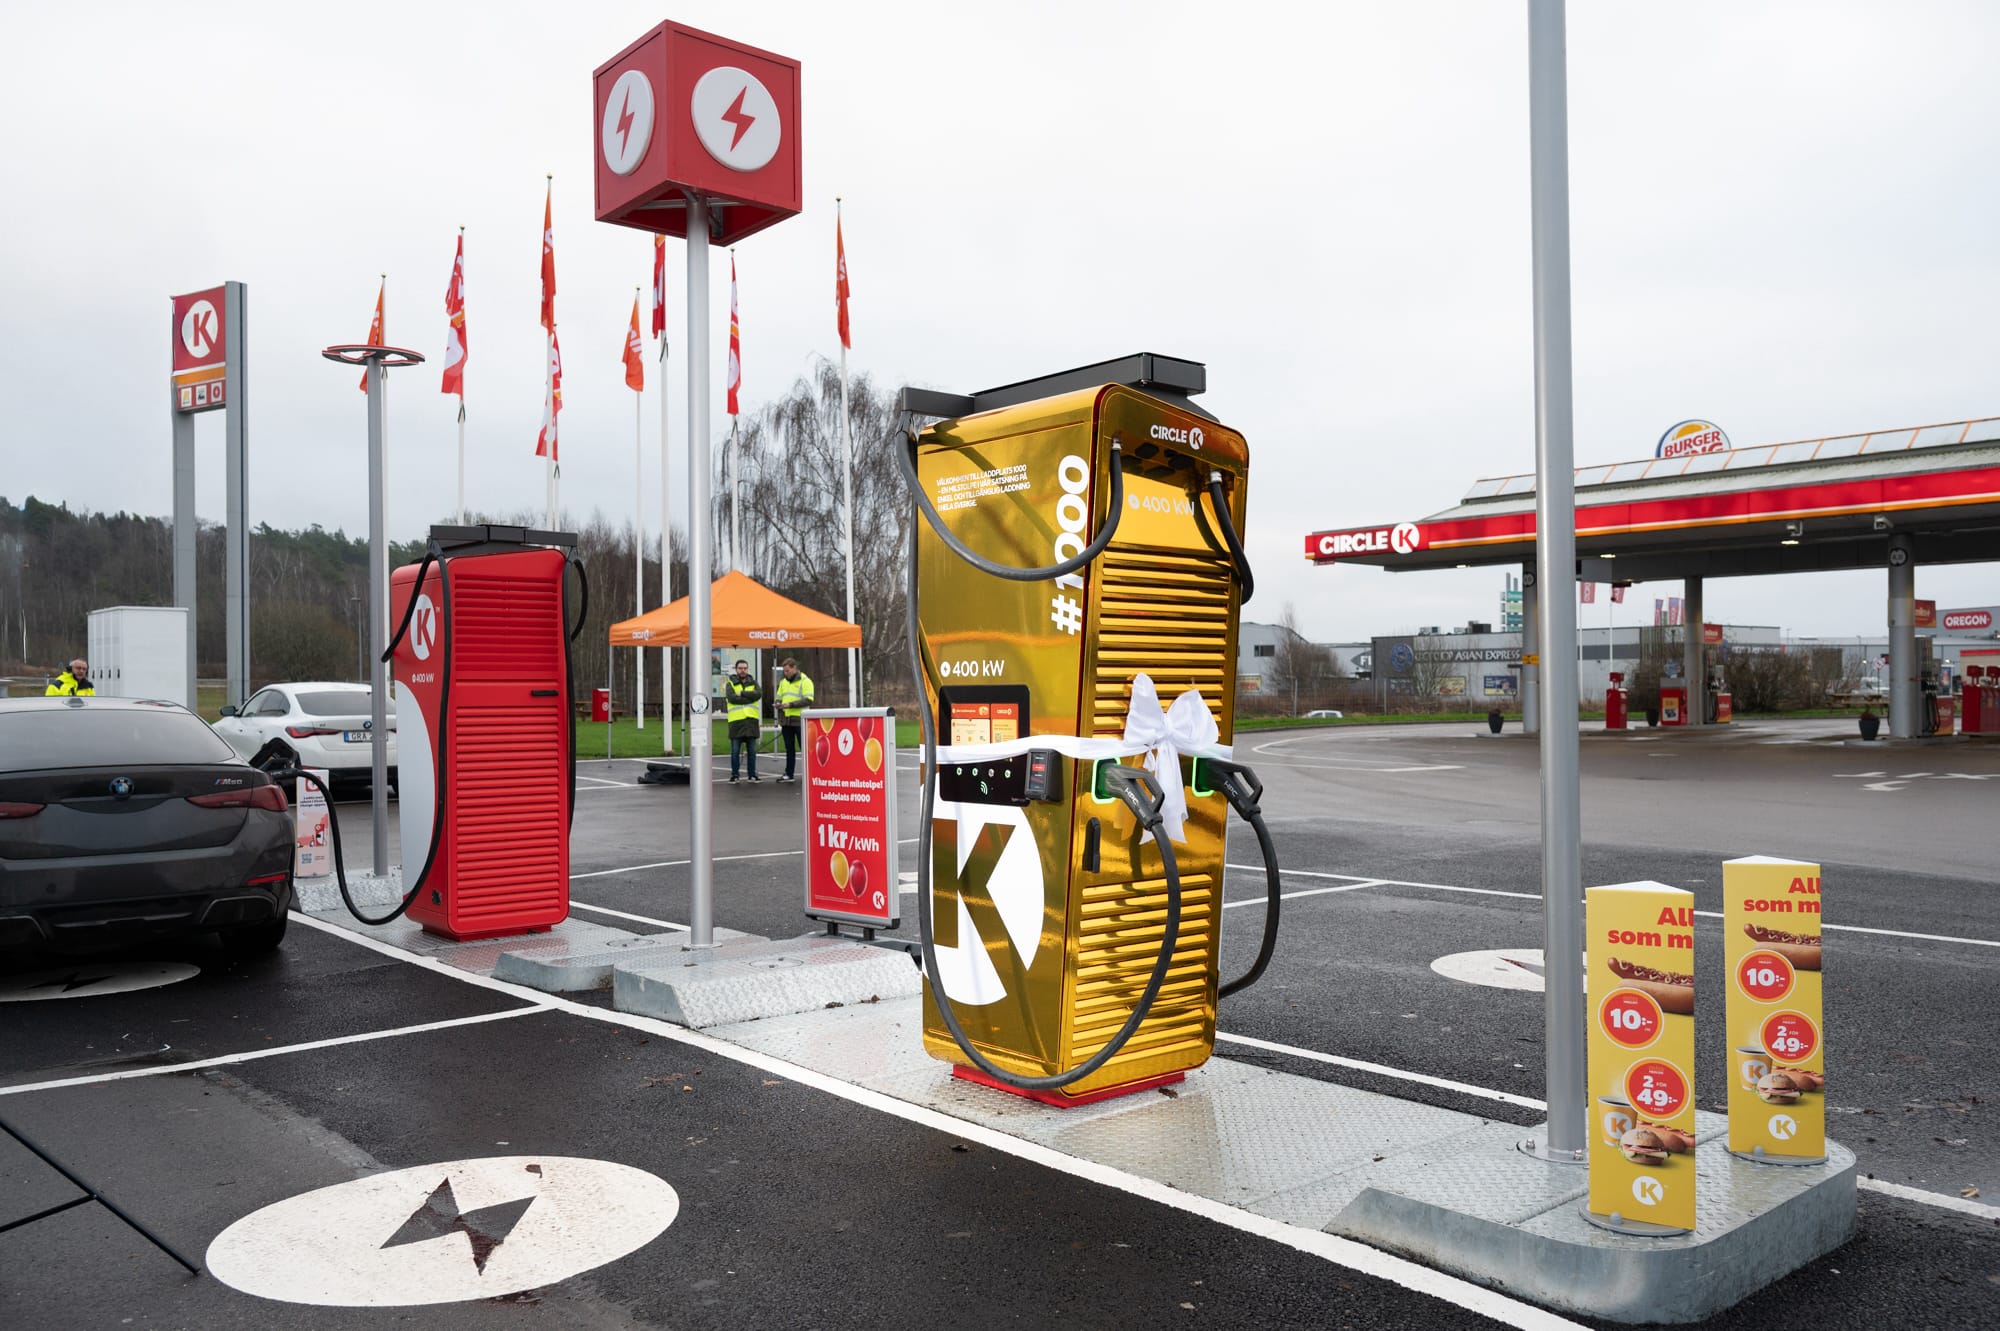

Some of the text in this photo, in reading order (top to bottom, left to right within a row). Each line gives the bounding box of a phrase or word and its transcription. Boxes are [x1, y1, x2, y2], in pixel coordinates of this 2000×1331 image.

[1150, 425, 1203, 449] CIRCLE K
[1664, 431, 1721, 458] BURGER
[936, 464, 1027, 487] VÄLKOMMEN TILL LADDPLATS 1000
[980, 479, 991, 488] VÅR
[992, 475, 1019, 486] SATSNING
[1019, 471, 1028, 481] PÅ
[1001, 482, 1030, 492] LADDNING
[1142, 496, 1195, 516] 400 kW
[1051, 454, 1089, 635] #1000
[1319, 526, 1417, 555] CIRCLE K
[1945, 615, 1988, 627] OREGON
[749, 631, 776, 640] CIRCLE
[1455, 650, 1483, 661] ASIAN
[1485, 649, 1521, 661] EXPRESS
[952, 660, 1005, 678] 400 kW
[352, 732, 367, 740] GRA
[812, 777, 819, 786] Vi
[849, 779, 883, 790] milstolpe!
[1223, 781, 1239, 797] HPC
[821, 792, 870, 803] Laddplats #1000
[1124, 786, 1139, 805] HPC
[818, 824, 880, 852] 1 kr /kWh
[1788, 877, 1821, 895] All
[928, 812, 1034, 996] K
[1743, 899, 1821, 914] som m
[1657, 906, 1694, 927] All
[1607, 930, 1693, 949] som m
[1746, 967, 1786, 987] 10:-
[1610, 1008, 1653, 1030] 10:-
[1777, 1025, 1787, 1037] 2
[1771, 1036, 1809, 1053] 49:-
[1643, 1075, 1655, 1089] 2
[1637, 1087, 1679, 1107] 49:-
[1773, 1117, 1794, 1138] K
[1638, 1179, 1660, 1204] K
